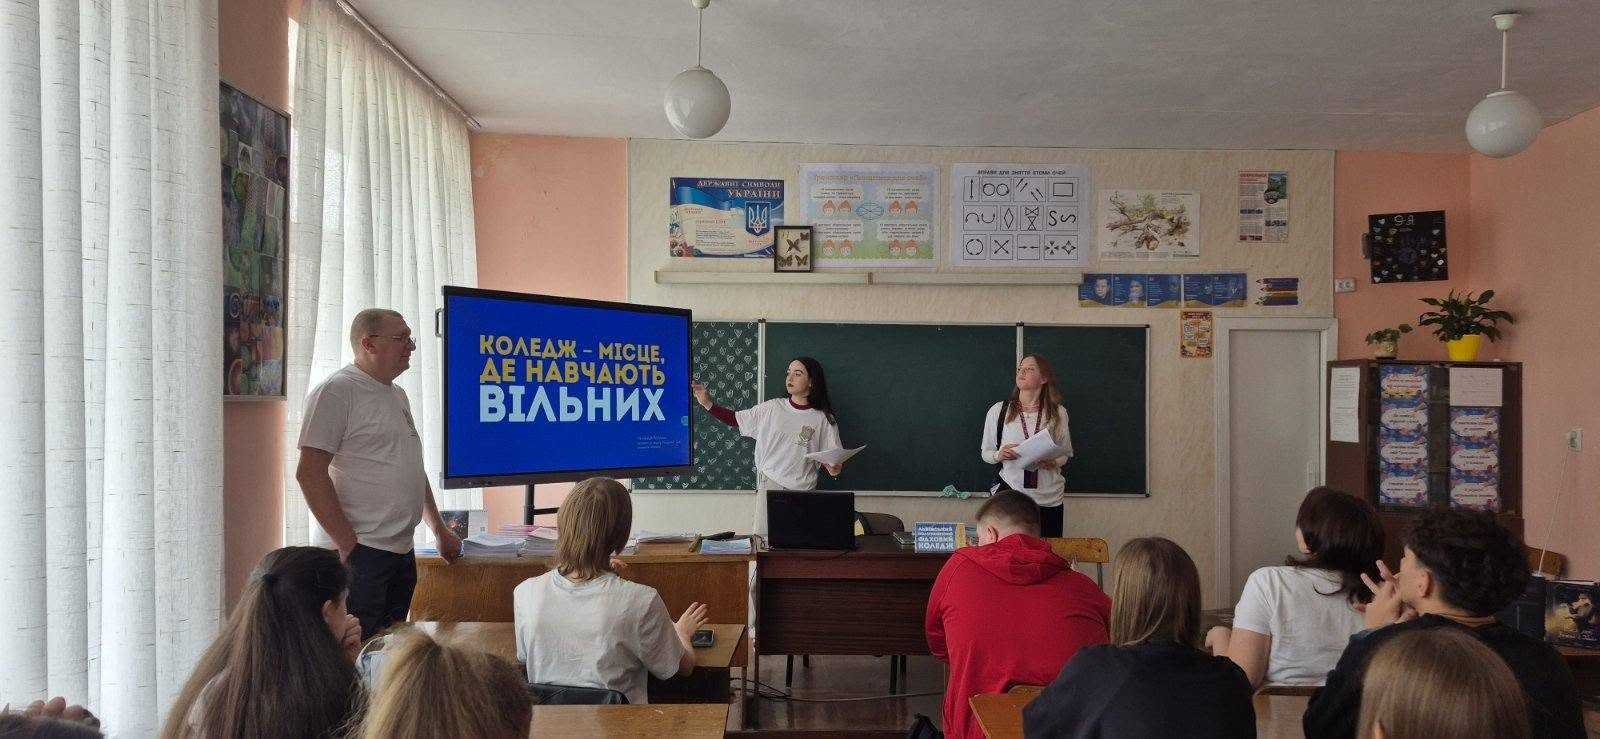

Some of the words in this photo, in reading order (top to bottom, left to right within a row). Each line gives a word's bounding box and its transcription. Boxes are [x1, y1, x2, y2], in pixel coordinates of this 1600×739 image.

[728, 188, 781, 199] УКРАЇНИ
[479, 334, 577, 359] КОЛЕДЖ
[598, 341, 665, 364] МІСЦЕ,
[479, 357, 516, 383] ДЕ
[526, 359, 666, 386] НАВЧАЮТЬ
[479, 384, 666, 423] ВІЛЬНИХ
[918, 542, 954, 550] КОЛЕДЖ
